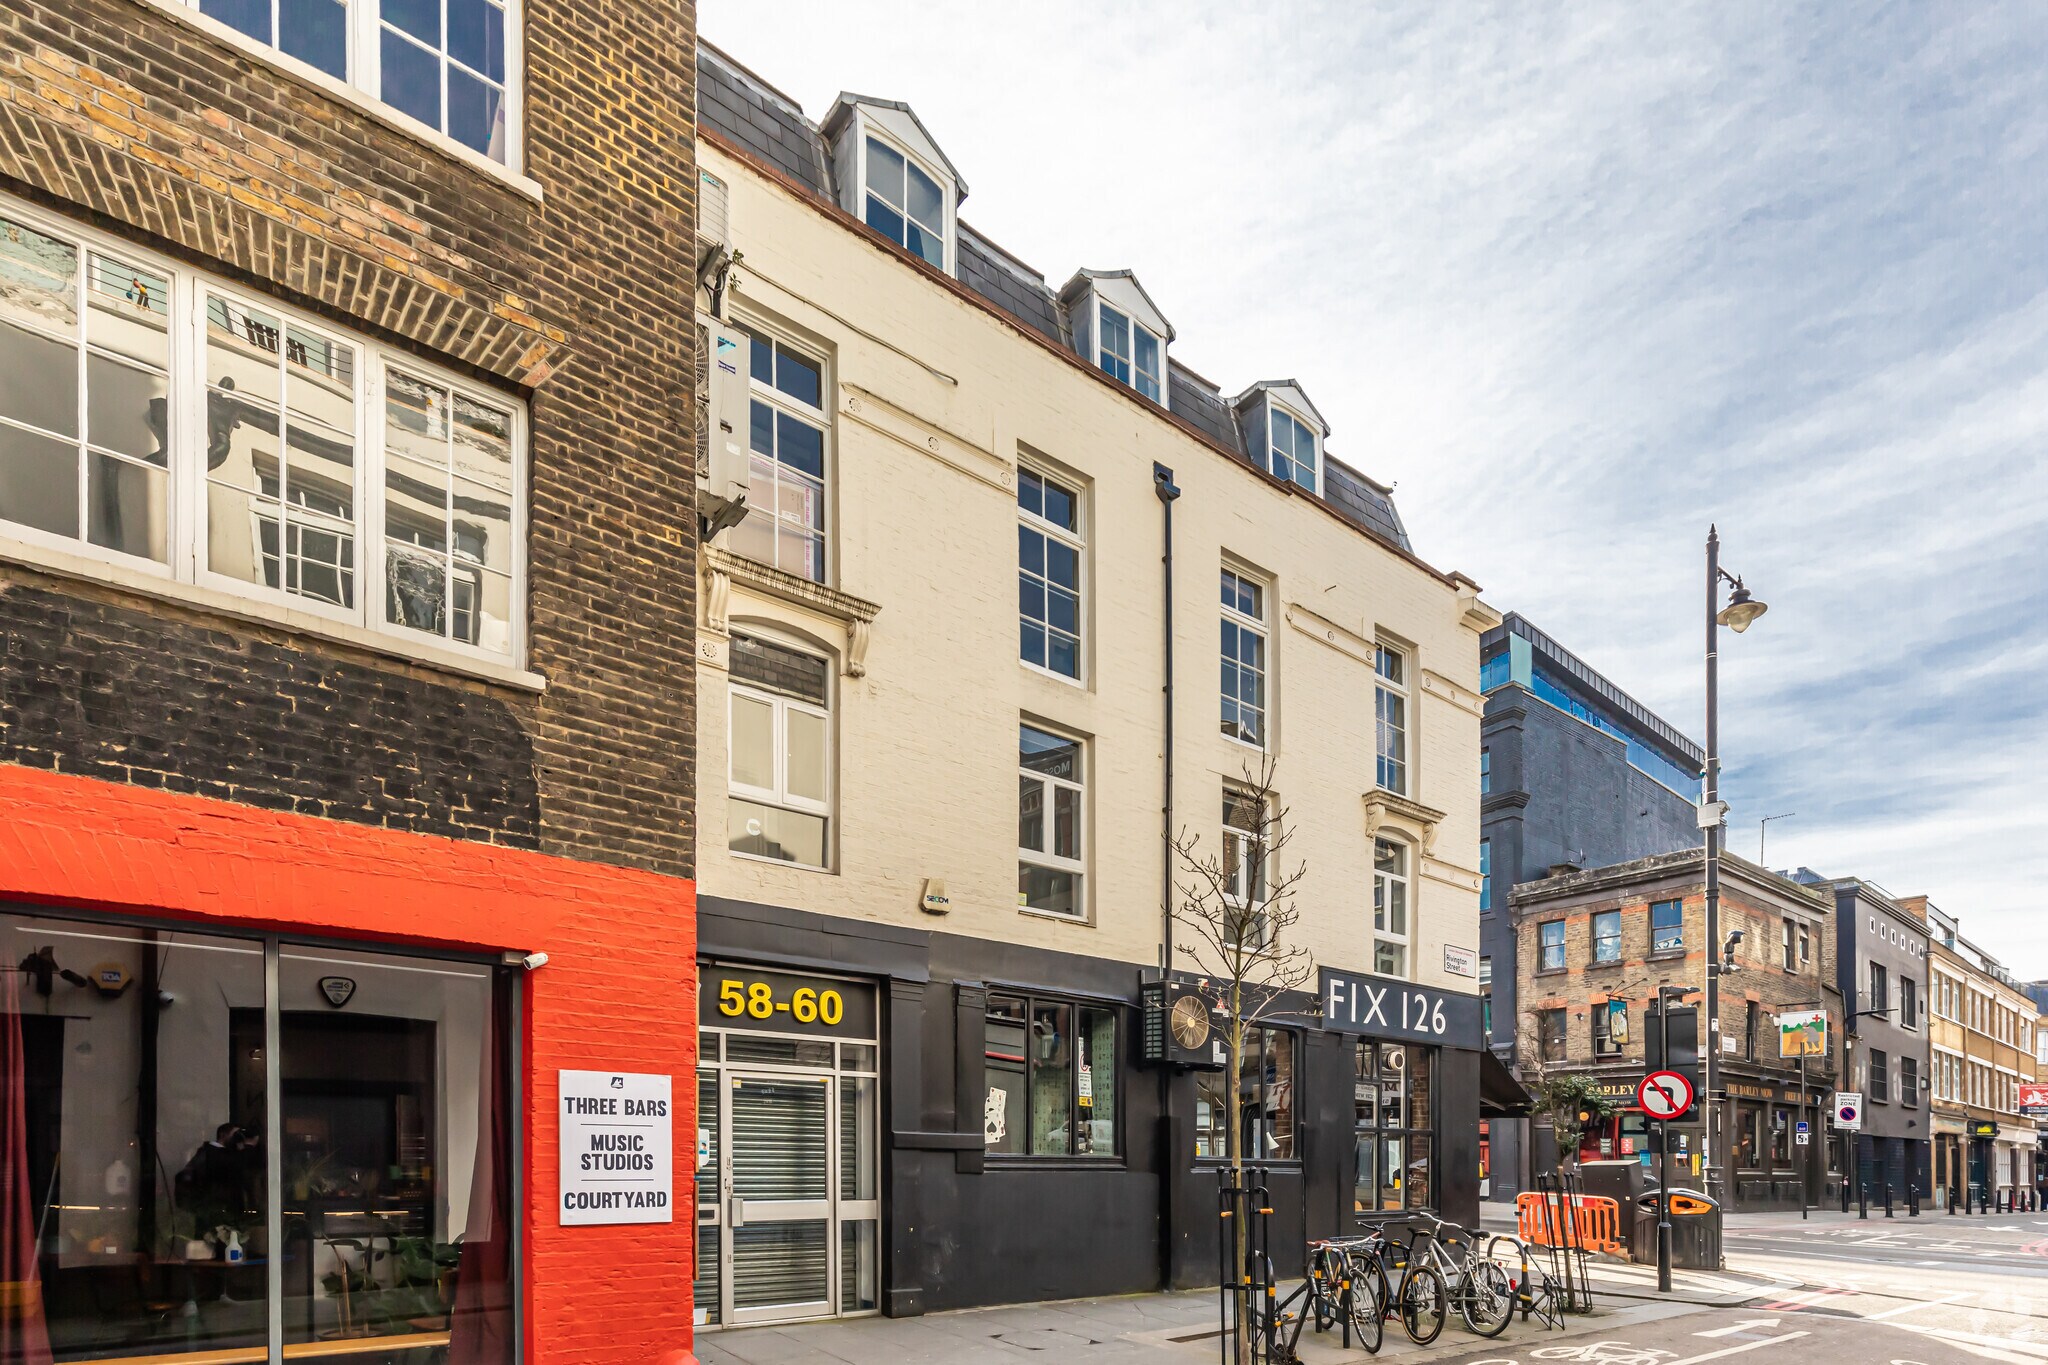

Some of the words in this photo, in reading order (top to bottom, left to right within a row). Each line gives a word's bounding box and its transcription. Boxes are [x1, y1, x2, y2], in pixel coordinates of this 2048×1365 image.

[927, 895, 949, 904] SECOM
[1446, 954, 1467, 965] Rivington
[1446, 962, 1460, 972] Street
[719, 979, 844, 1026] 58-60
[1329, 979, 1388, 1027] FIX
[1402, 991, 1447, 1035] 126
[1727, 1083, 1738, 1094] THE
[1739, 1084, 1759, 1097] BARLEY
[1760, 1088, 1773, 1098] MOW
[564, 1096, 617, 1115] THREE
[624, 1099, 667, 1117] BARS
[591, 1134, 644, 1152] MUSIC
[581, 1153, 654, 1170] STUDIOS
[564, 1191, 667, 1210] COURTYARD
